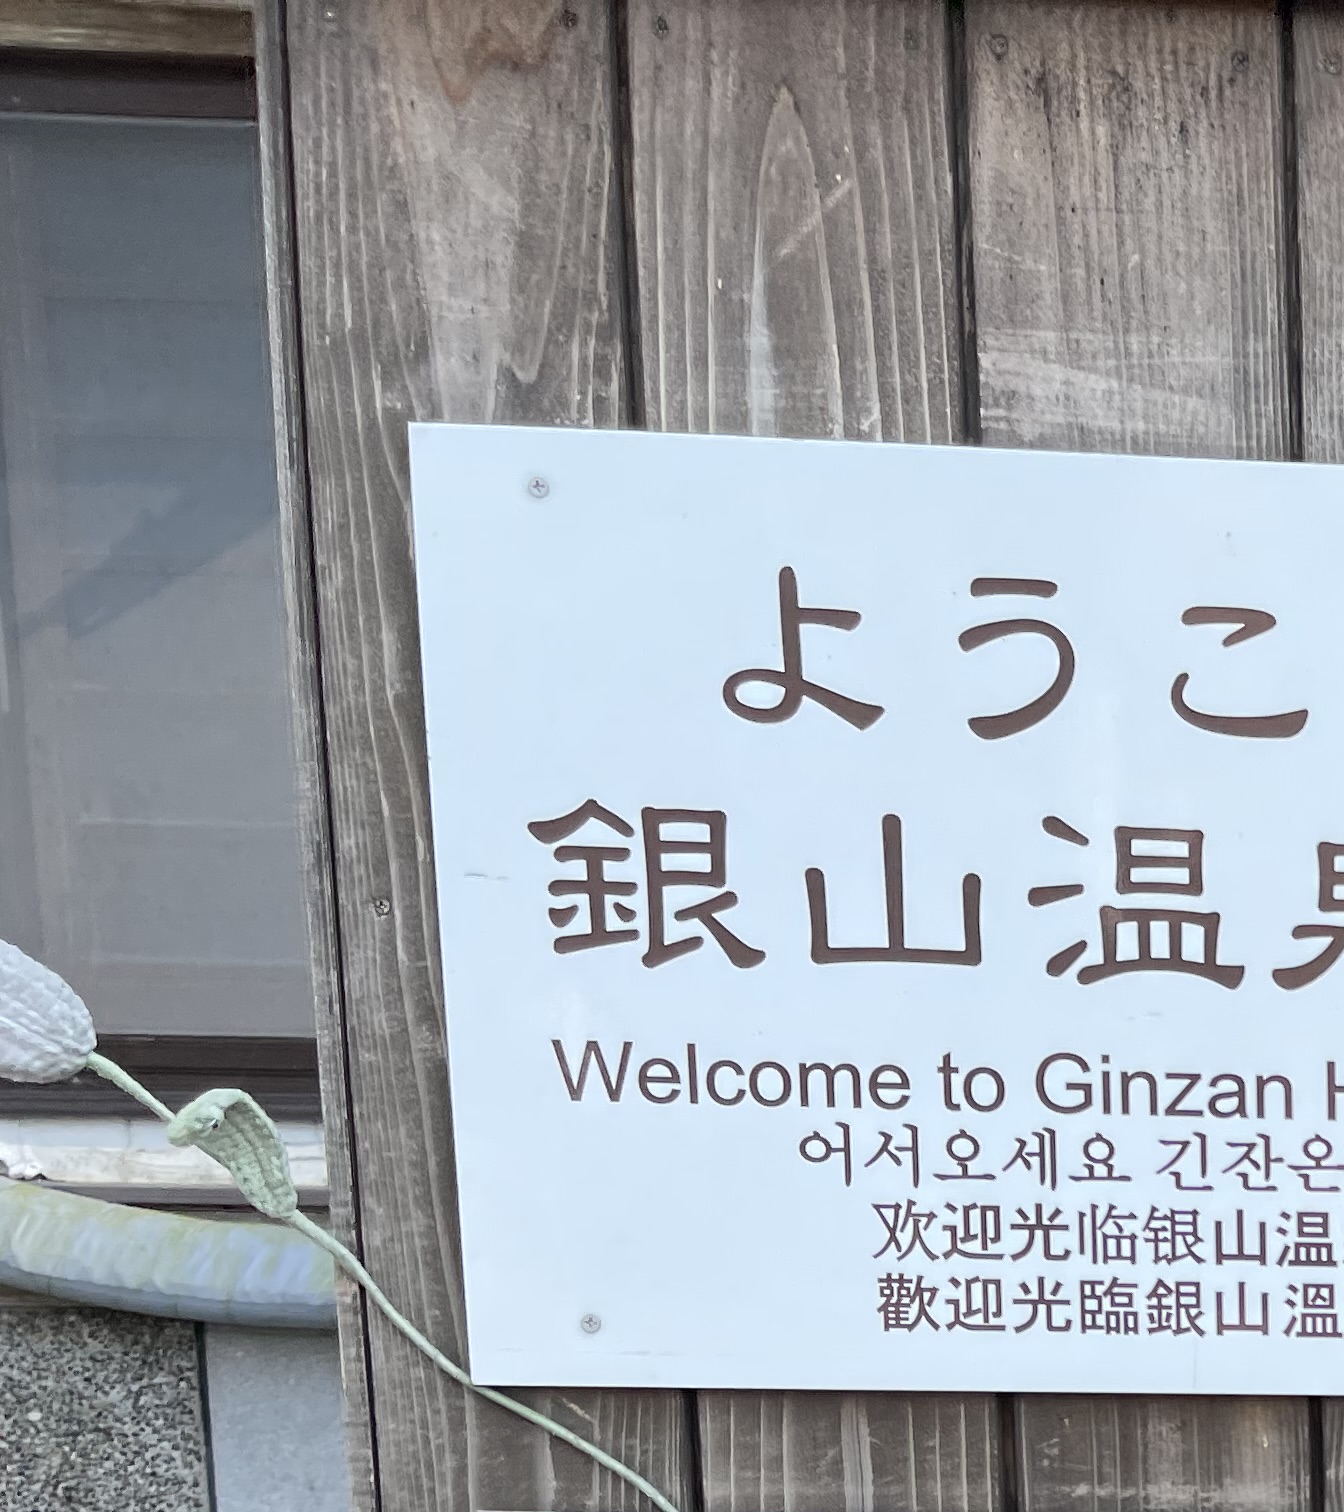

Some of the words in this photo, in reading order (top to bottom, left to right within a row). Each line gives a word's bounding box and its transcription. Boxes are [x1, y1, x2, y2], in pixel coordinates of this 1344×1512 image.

[551, 1039, 911, 1110] Welcome
[937, 1051, 1005, 1113] to
[1035, 1052, 1293, 1120] Ginzan
[799, 1121, 1132, 1192] 어서오세요
